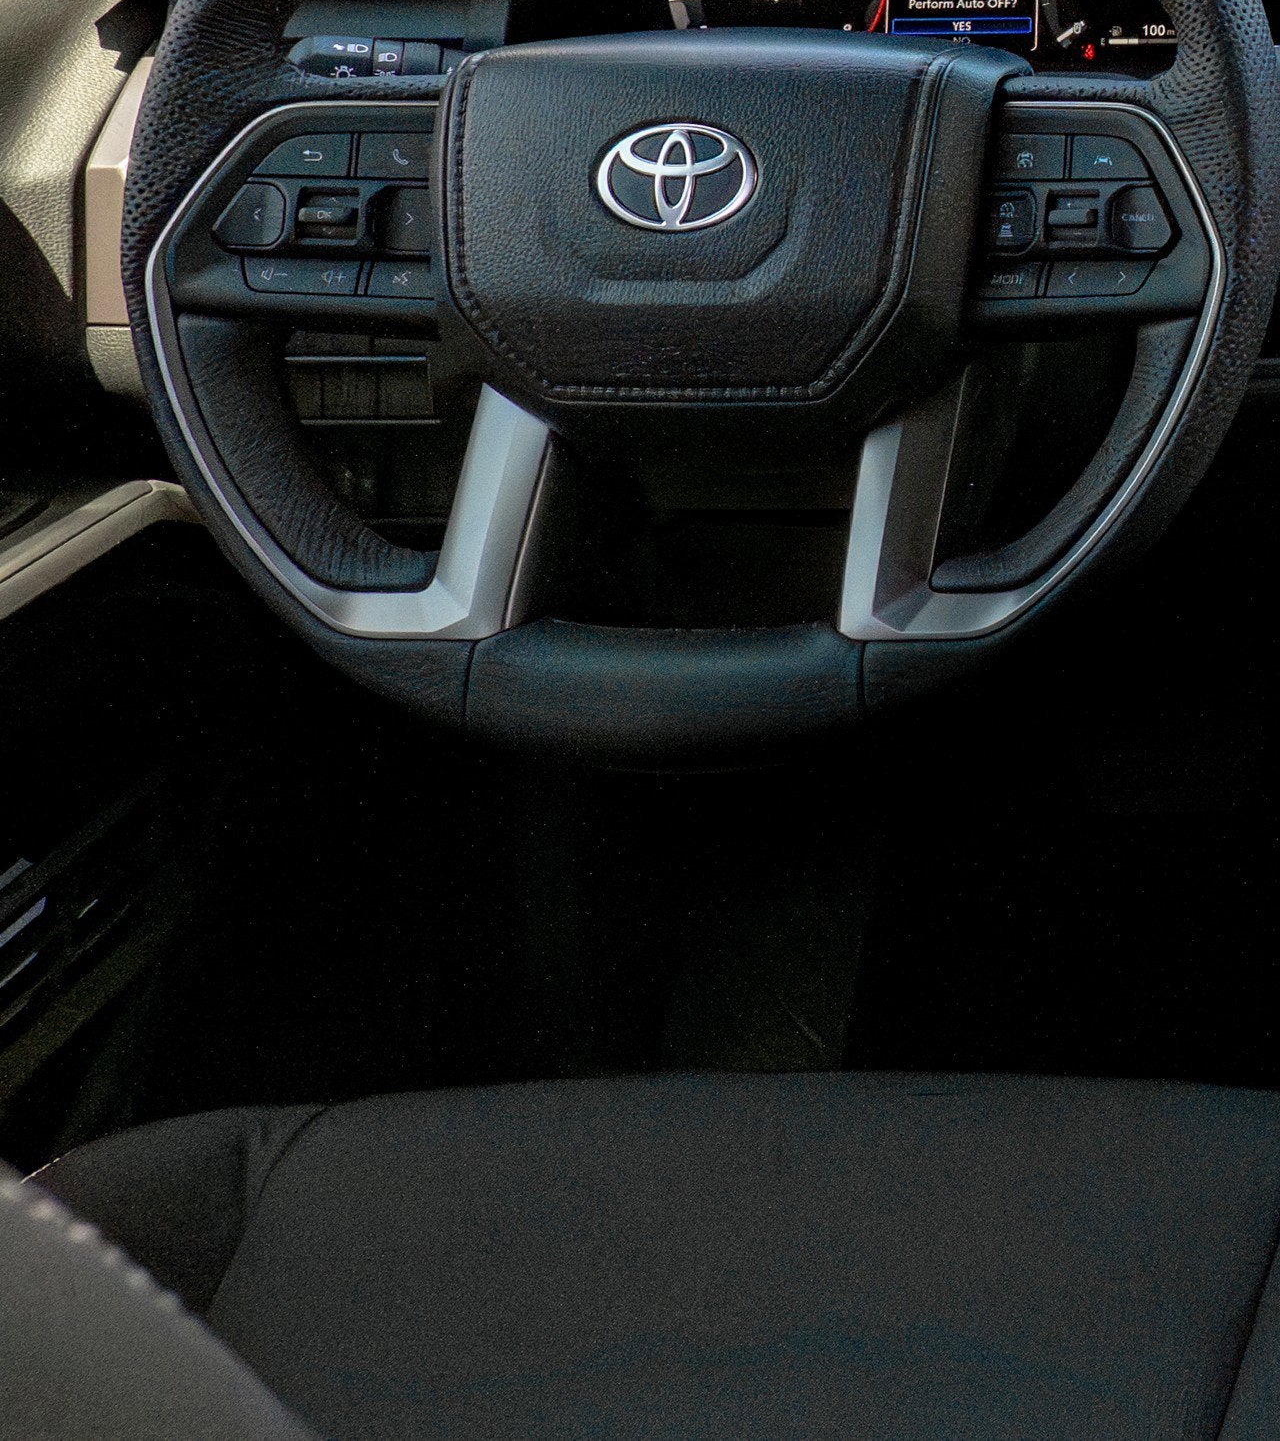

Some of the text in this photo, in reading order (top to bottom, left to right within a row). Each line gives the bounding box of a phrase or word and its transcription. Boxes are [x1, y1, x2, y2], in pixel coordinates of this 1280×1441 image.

[908, 0, 954, 9] Perform
[956, 0, 986, 9] Auto
[952, 22, 972, 31] YES
[1142, 24, 1166, 36] 100
